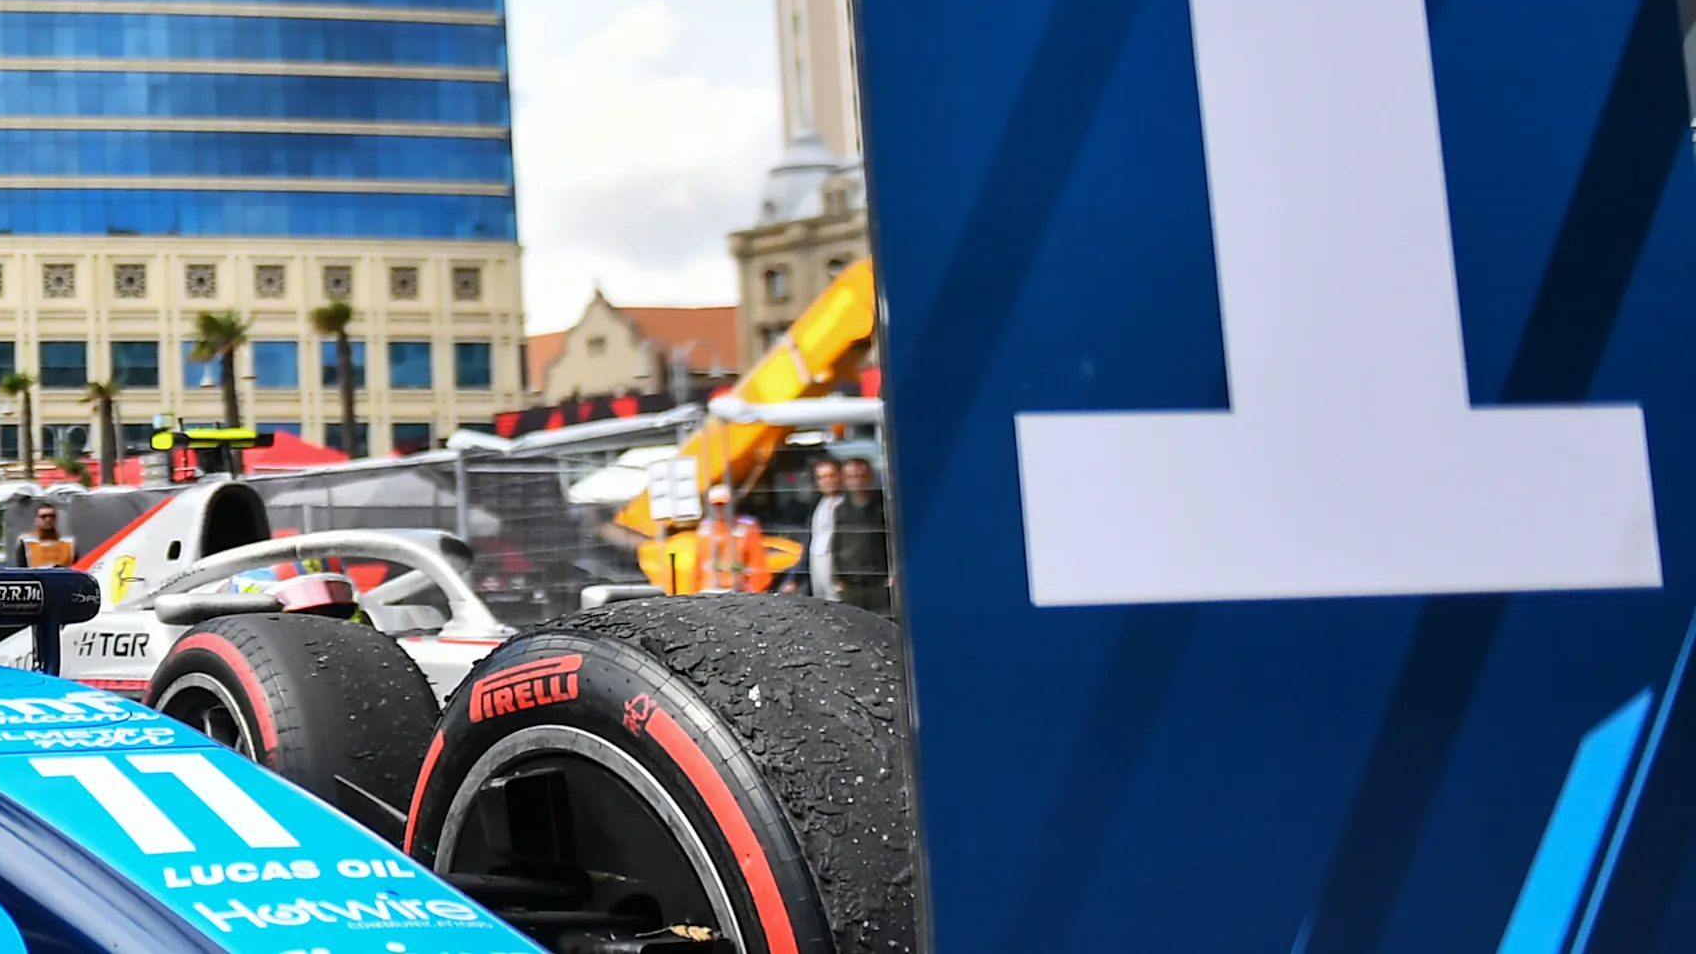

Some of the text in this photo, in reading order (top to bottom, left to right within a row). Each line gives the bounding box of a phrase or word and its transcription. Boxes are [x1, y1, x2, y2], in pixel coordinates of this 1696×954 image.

[469, 653, 584, 724] PIRELLI
[28, 753, 302, 855] 11
[162, 858, 416, 889] LUCAS OIL
[193, 892, 480, 933] Hotwire
